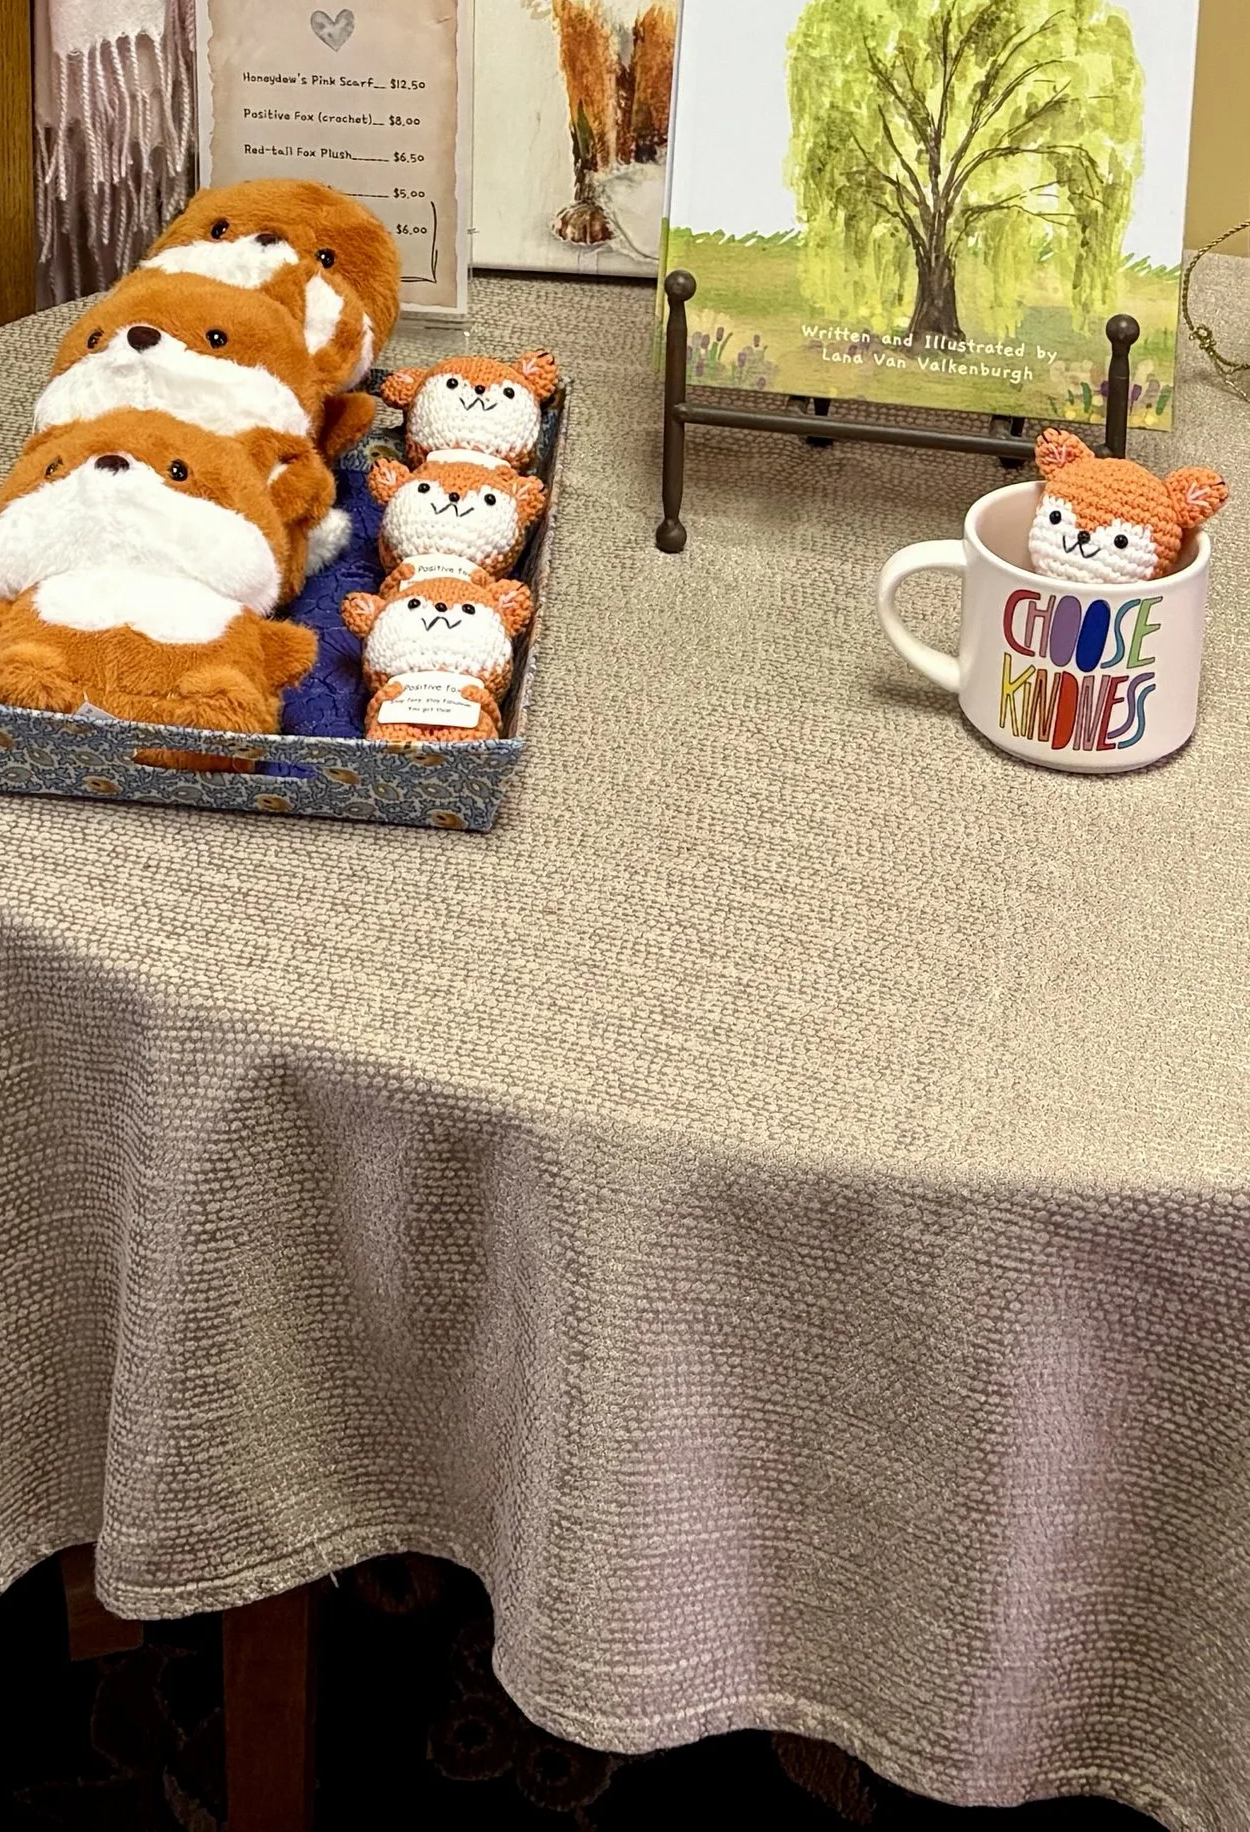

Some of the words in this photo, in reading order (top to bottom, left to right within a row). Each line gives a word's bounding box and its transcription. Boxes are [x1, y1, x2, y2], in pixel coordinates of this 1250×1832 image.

[243, 72, 307, 86] Honeydew's
[312, 75, 335, 86] Pink
[390, 78, 426, 90] $12.50
[243, 108, 290, 121] Positive
[294, 111, 314, 122] Fox
[389, 115, 421, 127] $8.00
[244, 144, 293, 156] Red-tail
[297, 147, 316, 158] Fox
[394, 151, 425, 163] $6.50
[393, 187, 426, 200] $5.00
[396, 223, 428, 235] $6.00
[801, 325, 871, 344] Written
[882, 333, 913, 348] and
[925, 334, 1025, 358] Illustrated
[1037, 345, 1058, 365] by
[822, 347, 863, 365] Lana
[874, 353, 906, 369] Van
[918, 357, 1033, 385] Valkenburgh
[1003, 589, 1163, 673] CHOOSE
[403, 683, 442, 692] Positive
[999, 652, 1156, 751] KINDNESS
